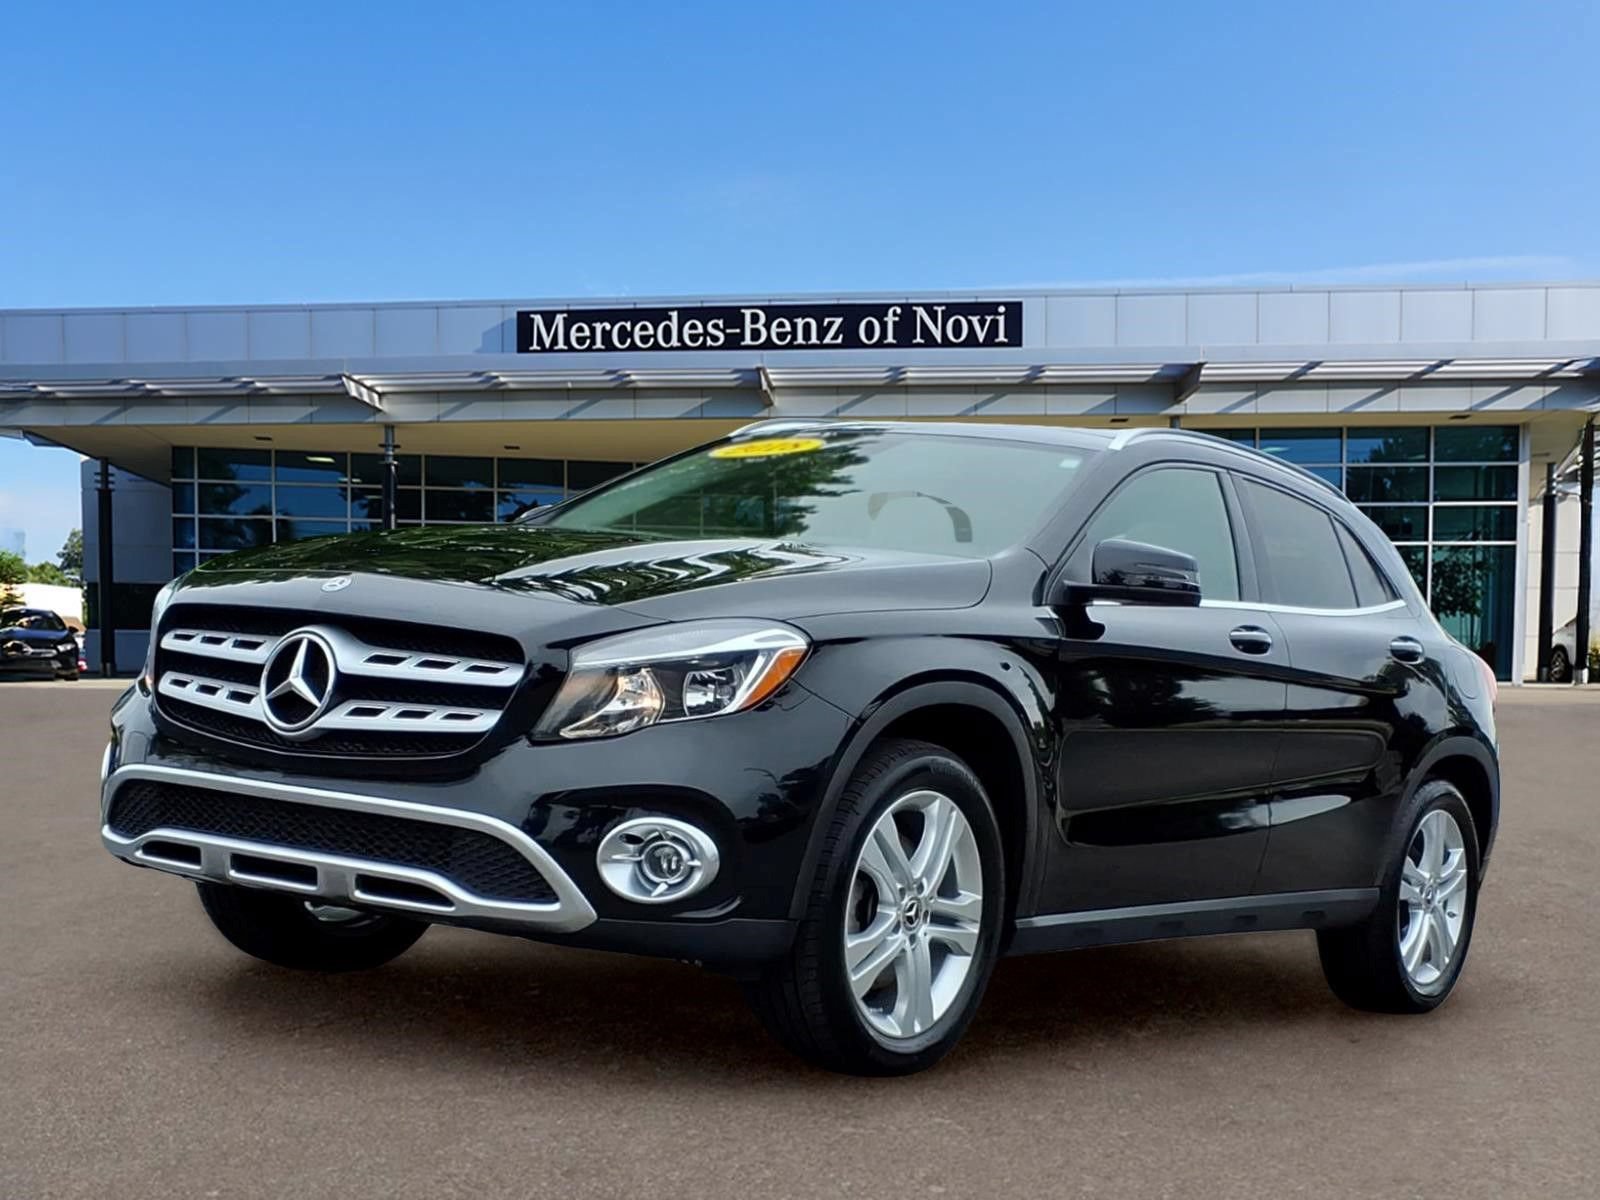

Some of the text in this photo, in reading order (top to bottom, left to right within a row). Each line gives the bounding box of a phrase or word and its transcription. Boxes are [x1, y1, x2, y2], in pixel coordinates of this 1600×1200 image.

[528, 305, 1008, 350] Mercedes-Benz of Novi
